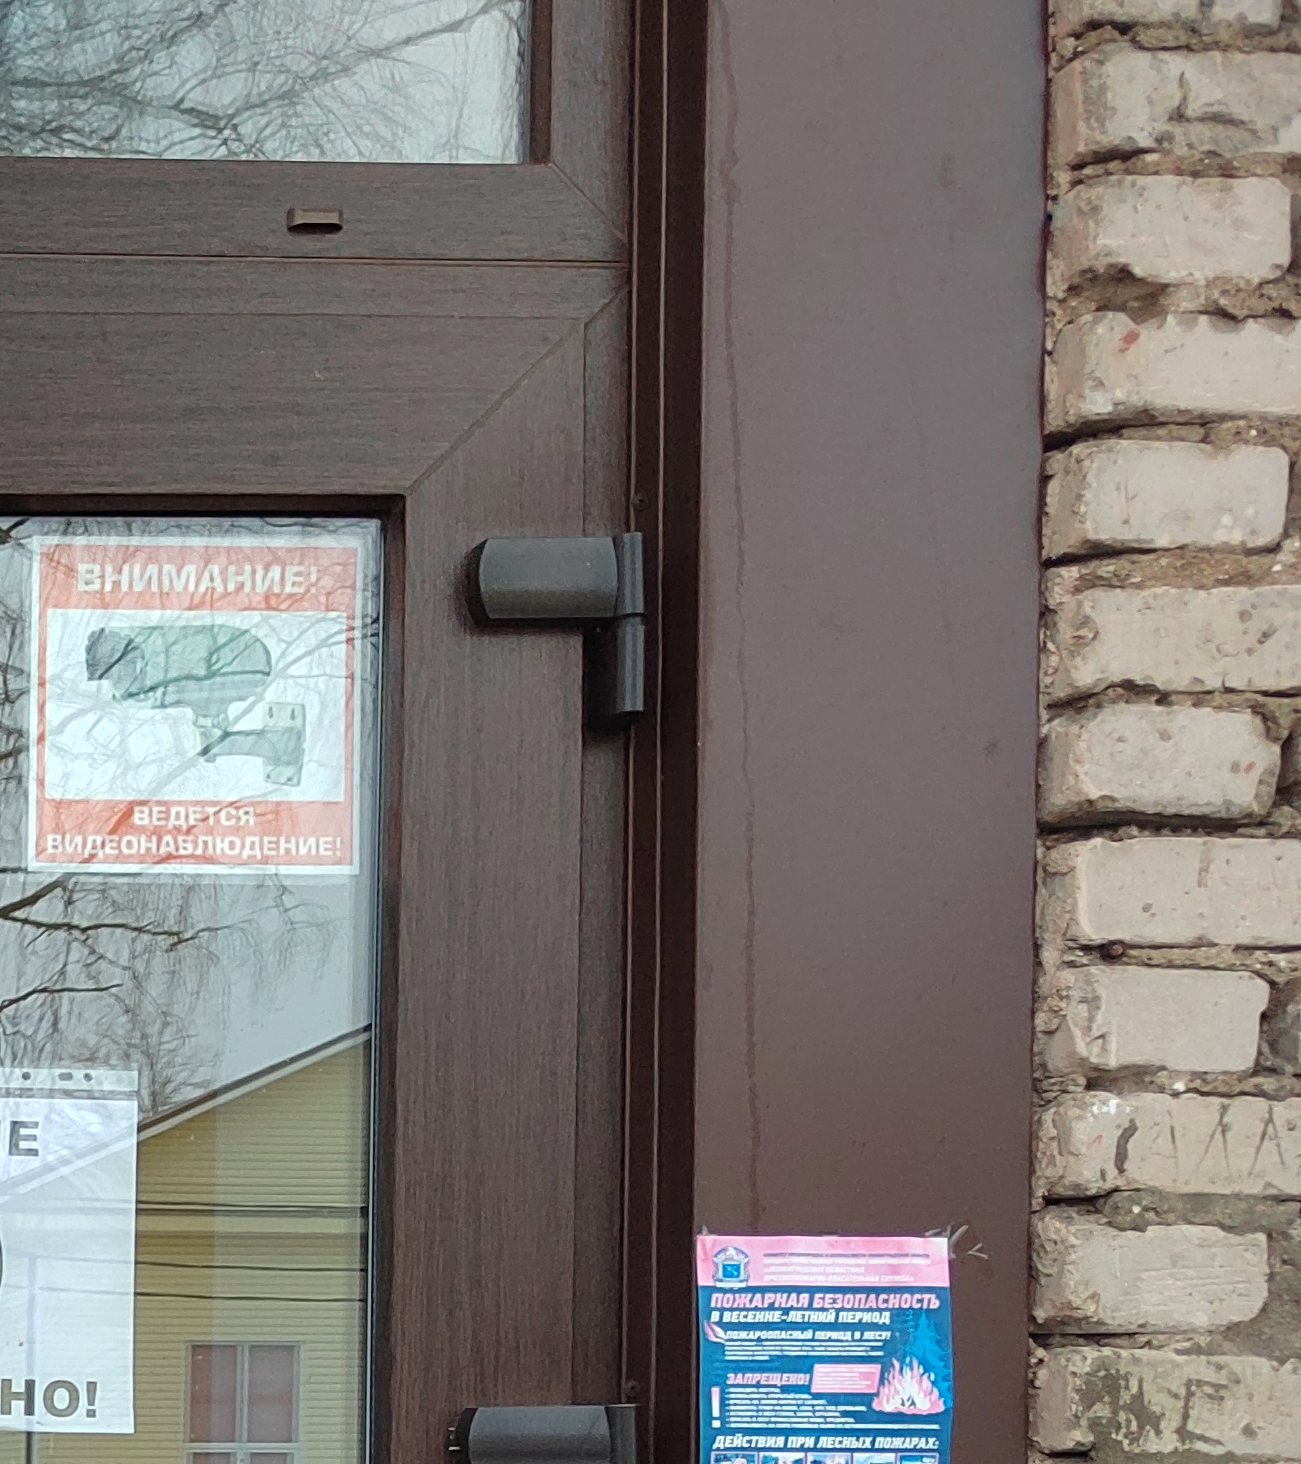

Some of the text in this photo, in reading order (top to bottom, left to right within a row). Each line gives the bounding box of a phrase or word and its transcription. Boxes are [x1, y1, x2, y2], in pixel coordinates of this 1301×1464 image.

[77, 562, 319, 594] ВНИМАНИЕ!
[133, 805, 255, 827] ВЕДЕТСЯ
[47, 833, 342, 859] ВИДЕОНАБЛЮДЕНИЕ!
[710, 1292, 940, 1309] ПОЖАРНАЯ БЕЗОПАСНОСТЬ
[710, 1309, 890, 1325] В ВЕСЕННЕ-ЛЕТНИЙ ПЕРИОД
[726, 1372, 810, 1386] ЗАПРЕЩЕНО!
[712, 1435, 939, 1449] ДЕЙСТВИЯ ПРИ ЛЕСНЫХ ПОЖАРАХ:
